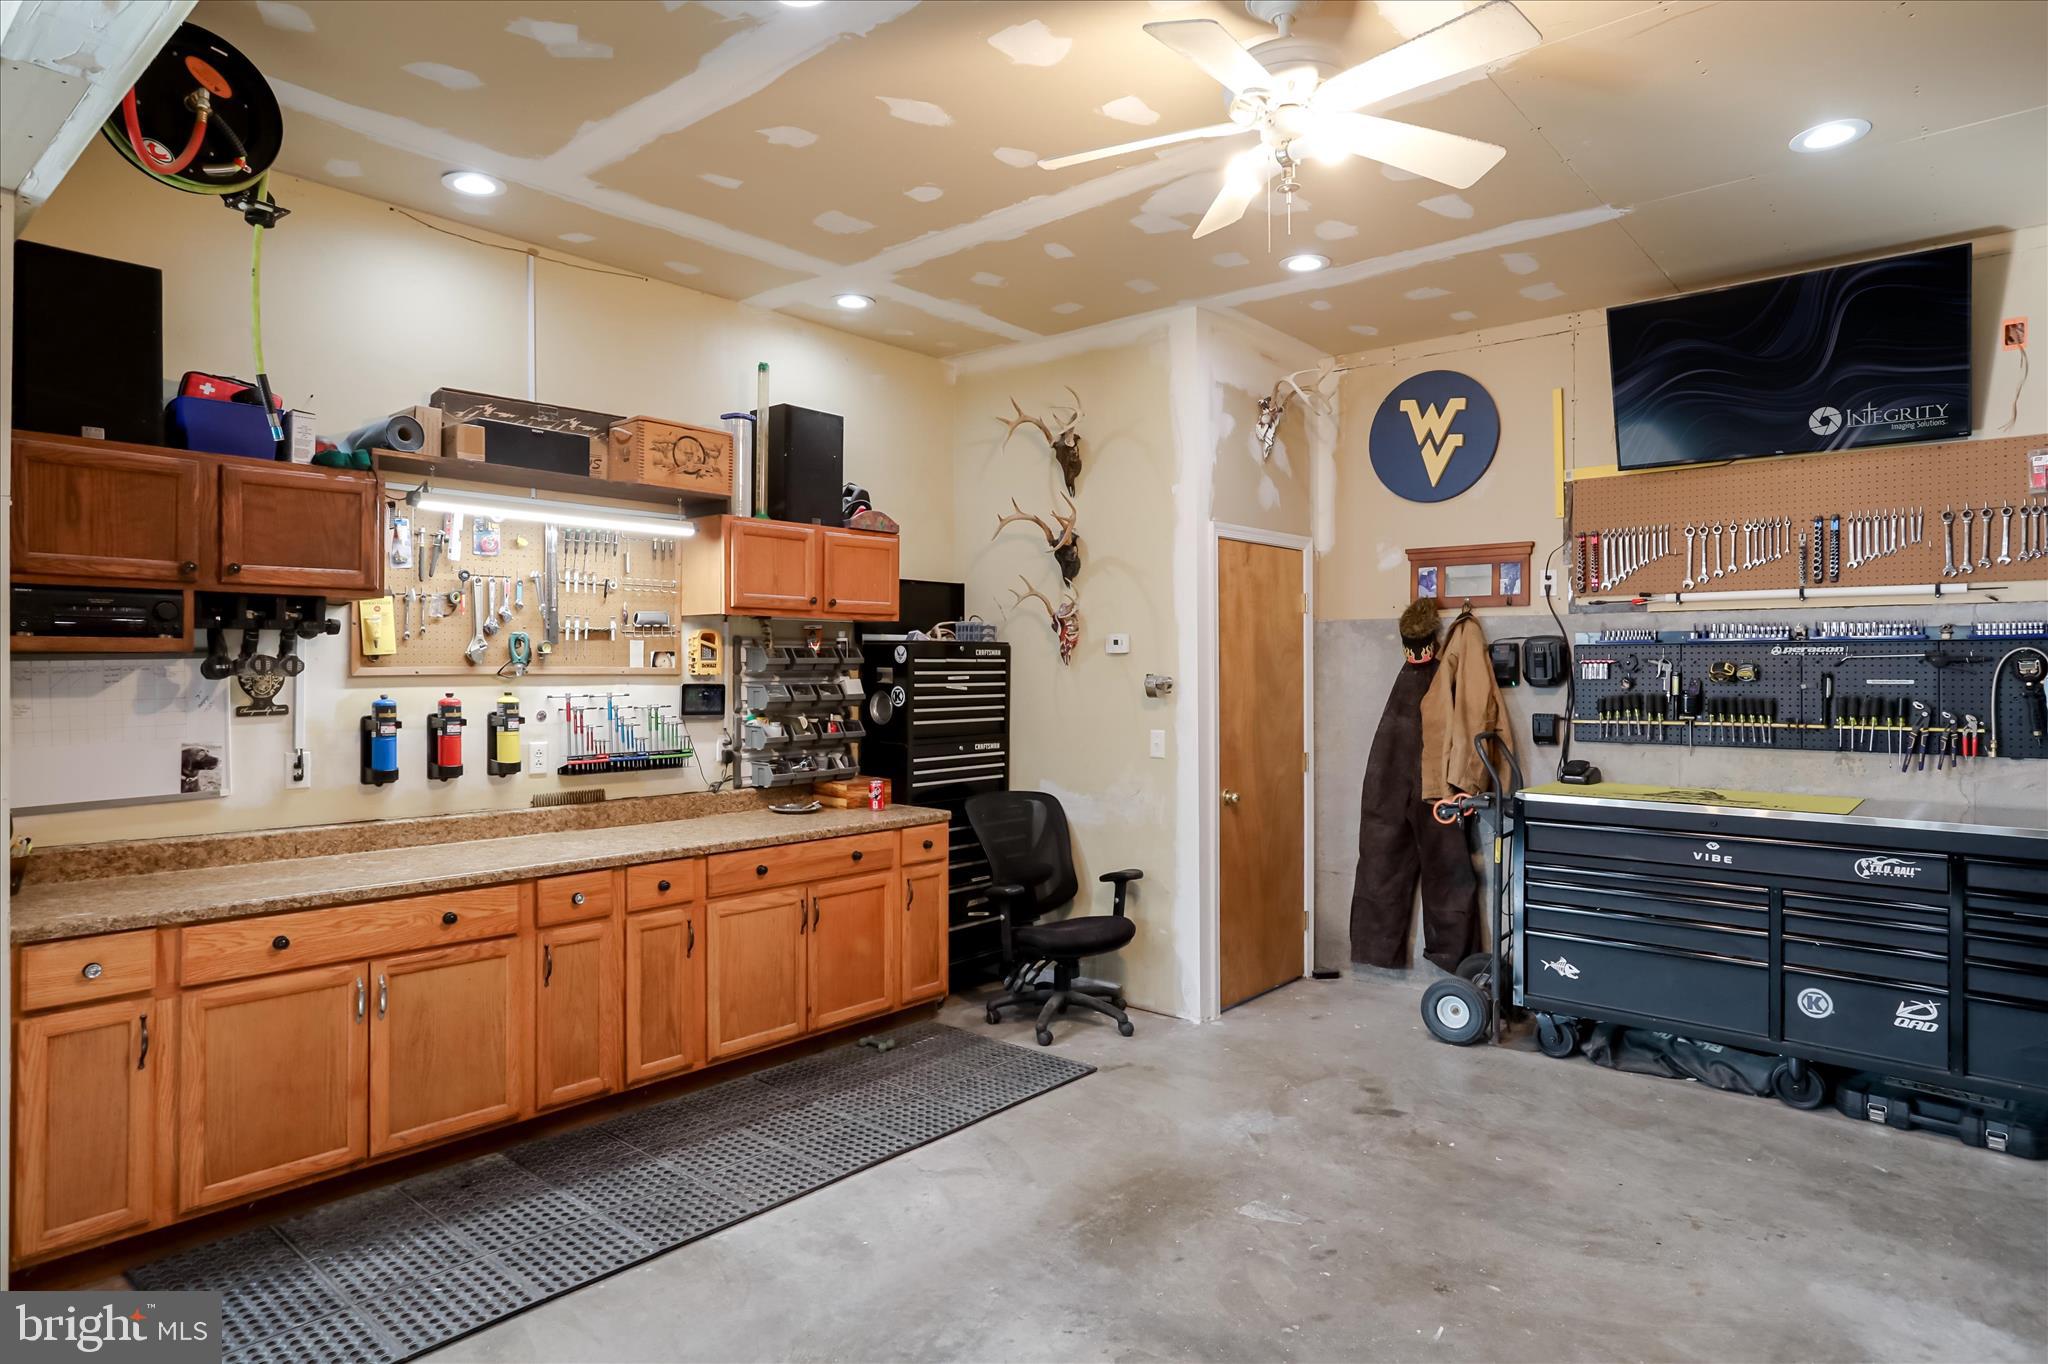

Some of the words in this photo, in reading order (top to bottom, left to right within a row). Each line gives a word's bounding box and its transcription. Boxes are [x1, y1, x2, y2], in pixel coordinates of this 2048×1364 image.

[1846, 401, 1949, 426] INTEGRITY
[1891, 420, 1916, 431] Imaging
[1917, 419, 1946, 429] Solutions
[974, 742, 1001, 750] CRAFTSMAN
[1693, 851, 1733, 864] VIBE
[1893, 1017, 1939, 1033] QAD
